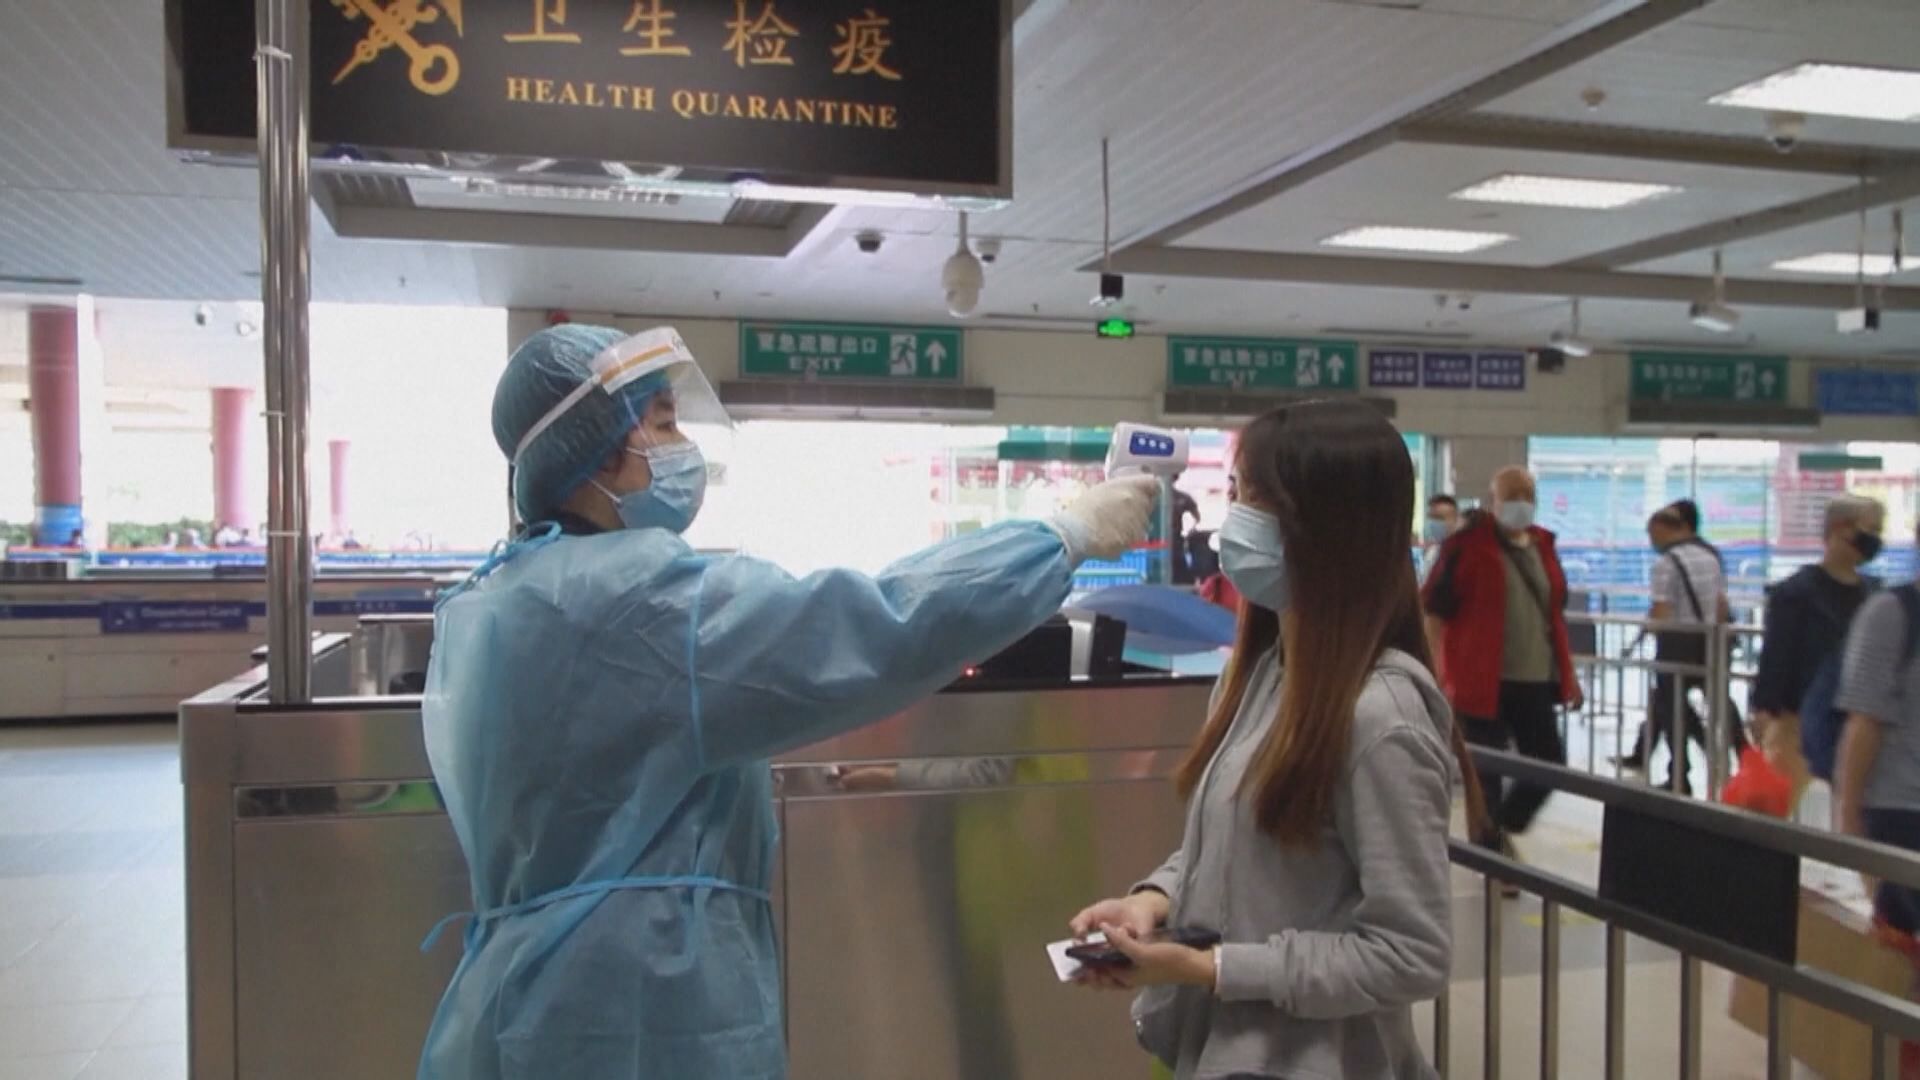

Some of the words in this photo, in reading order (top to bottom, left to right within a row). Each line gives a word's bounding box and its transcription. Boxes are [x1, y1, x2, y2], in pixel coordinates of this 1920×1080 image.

[503, 0, 902, 81] 卫生检疫
[505, 76, 656, 112] HEALTH
[670, 88, 899, 130] QUARANTINE
[788, 356, 845, 373] EXIT
